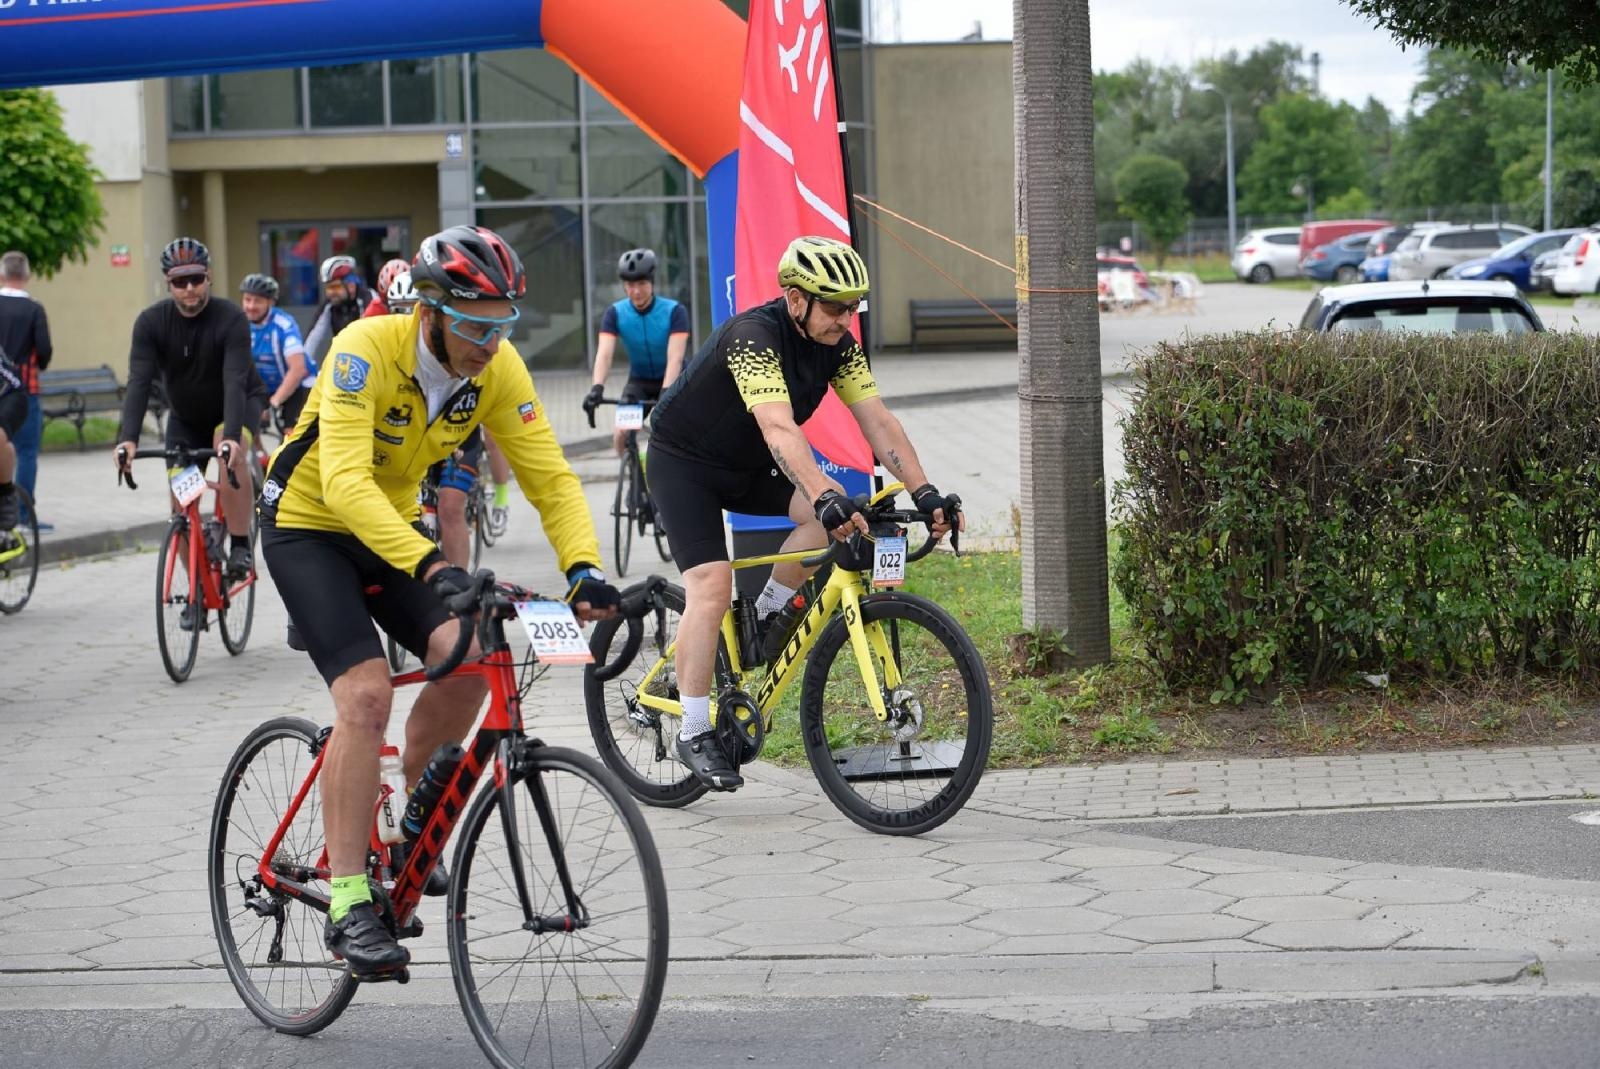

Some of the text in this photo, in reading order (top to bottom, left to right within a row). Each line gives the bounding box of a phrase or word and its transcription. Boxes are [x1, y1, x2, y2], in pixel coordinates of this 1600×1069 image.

[791, 268, 817, 285] SCOTT
[750, 387, 787, 397] SCOTT
[880, 553, 901, 569] 022
[529, 622, 579, 640] 2085
[758, 586, 827, 711] SCOTT
